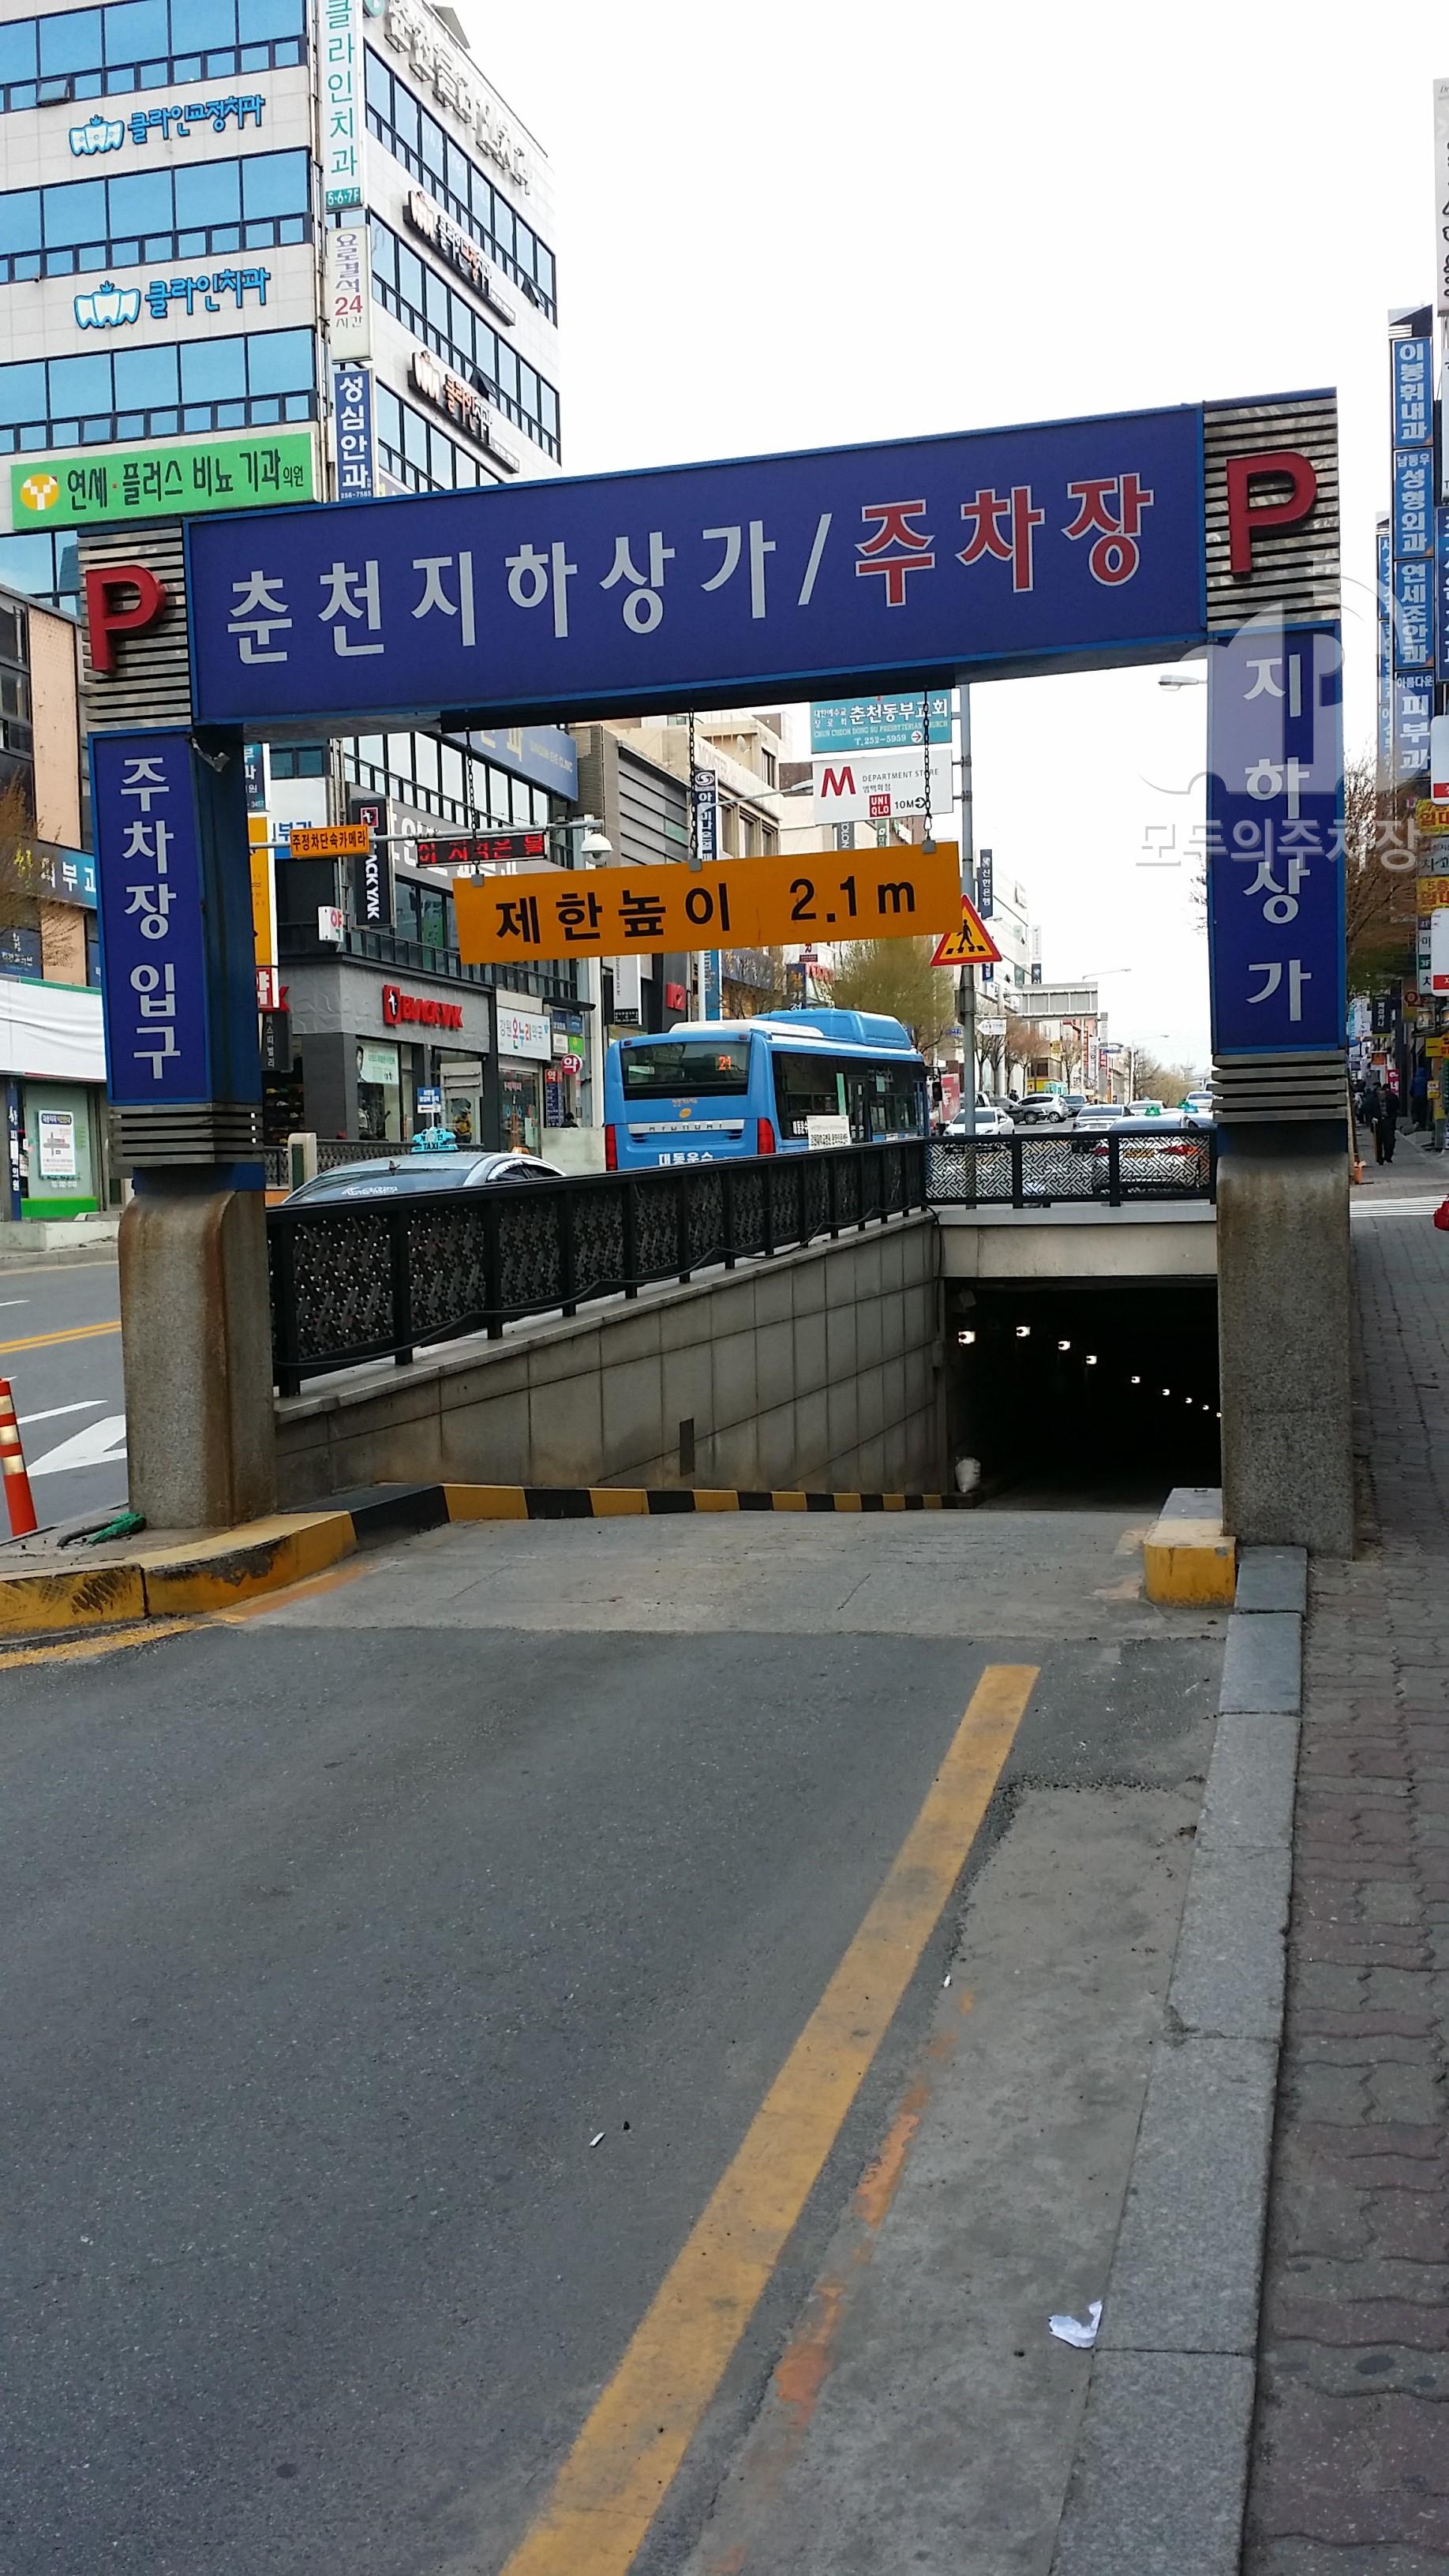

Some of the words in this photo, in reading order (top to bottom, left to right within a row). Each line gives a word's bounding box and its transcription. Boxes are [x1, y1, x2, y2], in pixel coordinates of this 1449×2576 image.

[128, 95, 265, 144] 클라인교정치과
[335, 234, 360, 293] 요로결석
[145, 268, 271, 319] 클라인치과
[335, 295, 363, 316] 24
[335, 317, 363, 329] 시간
[339, 376, 369, 489] 성심안과
[1225, 451, 1319, 581] P
[1401, 469, 1428, 552] 성형외과
[86, 564, 167, 675] P
[1397, 675, 1433, 688] 아름다운
[848, 698, 948, 725] 춘천동부교회
[1400, 695, 1430, 770] 피부과
[820, 766, 856, 798] M
[862, 771, 912, 782] DEPARTMENT
[871, 796, 888, 806] UNI
[871, 805, 889, 816] QLO
[894, 799, 914, 810] 10M
[291, 829, 366, 852] 주정차단속카메라
[1241, 654, 1311, 1021] 지하상가
[418, 842, 436, 863] 이
[982, 869, 990, 906] 신한은행
[496, 882, 731, 945] 제한높이
[563, 1057, 578, 1073] 약
[649, 1121, 722, 1132] HYUNDAI
